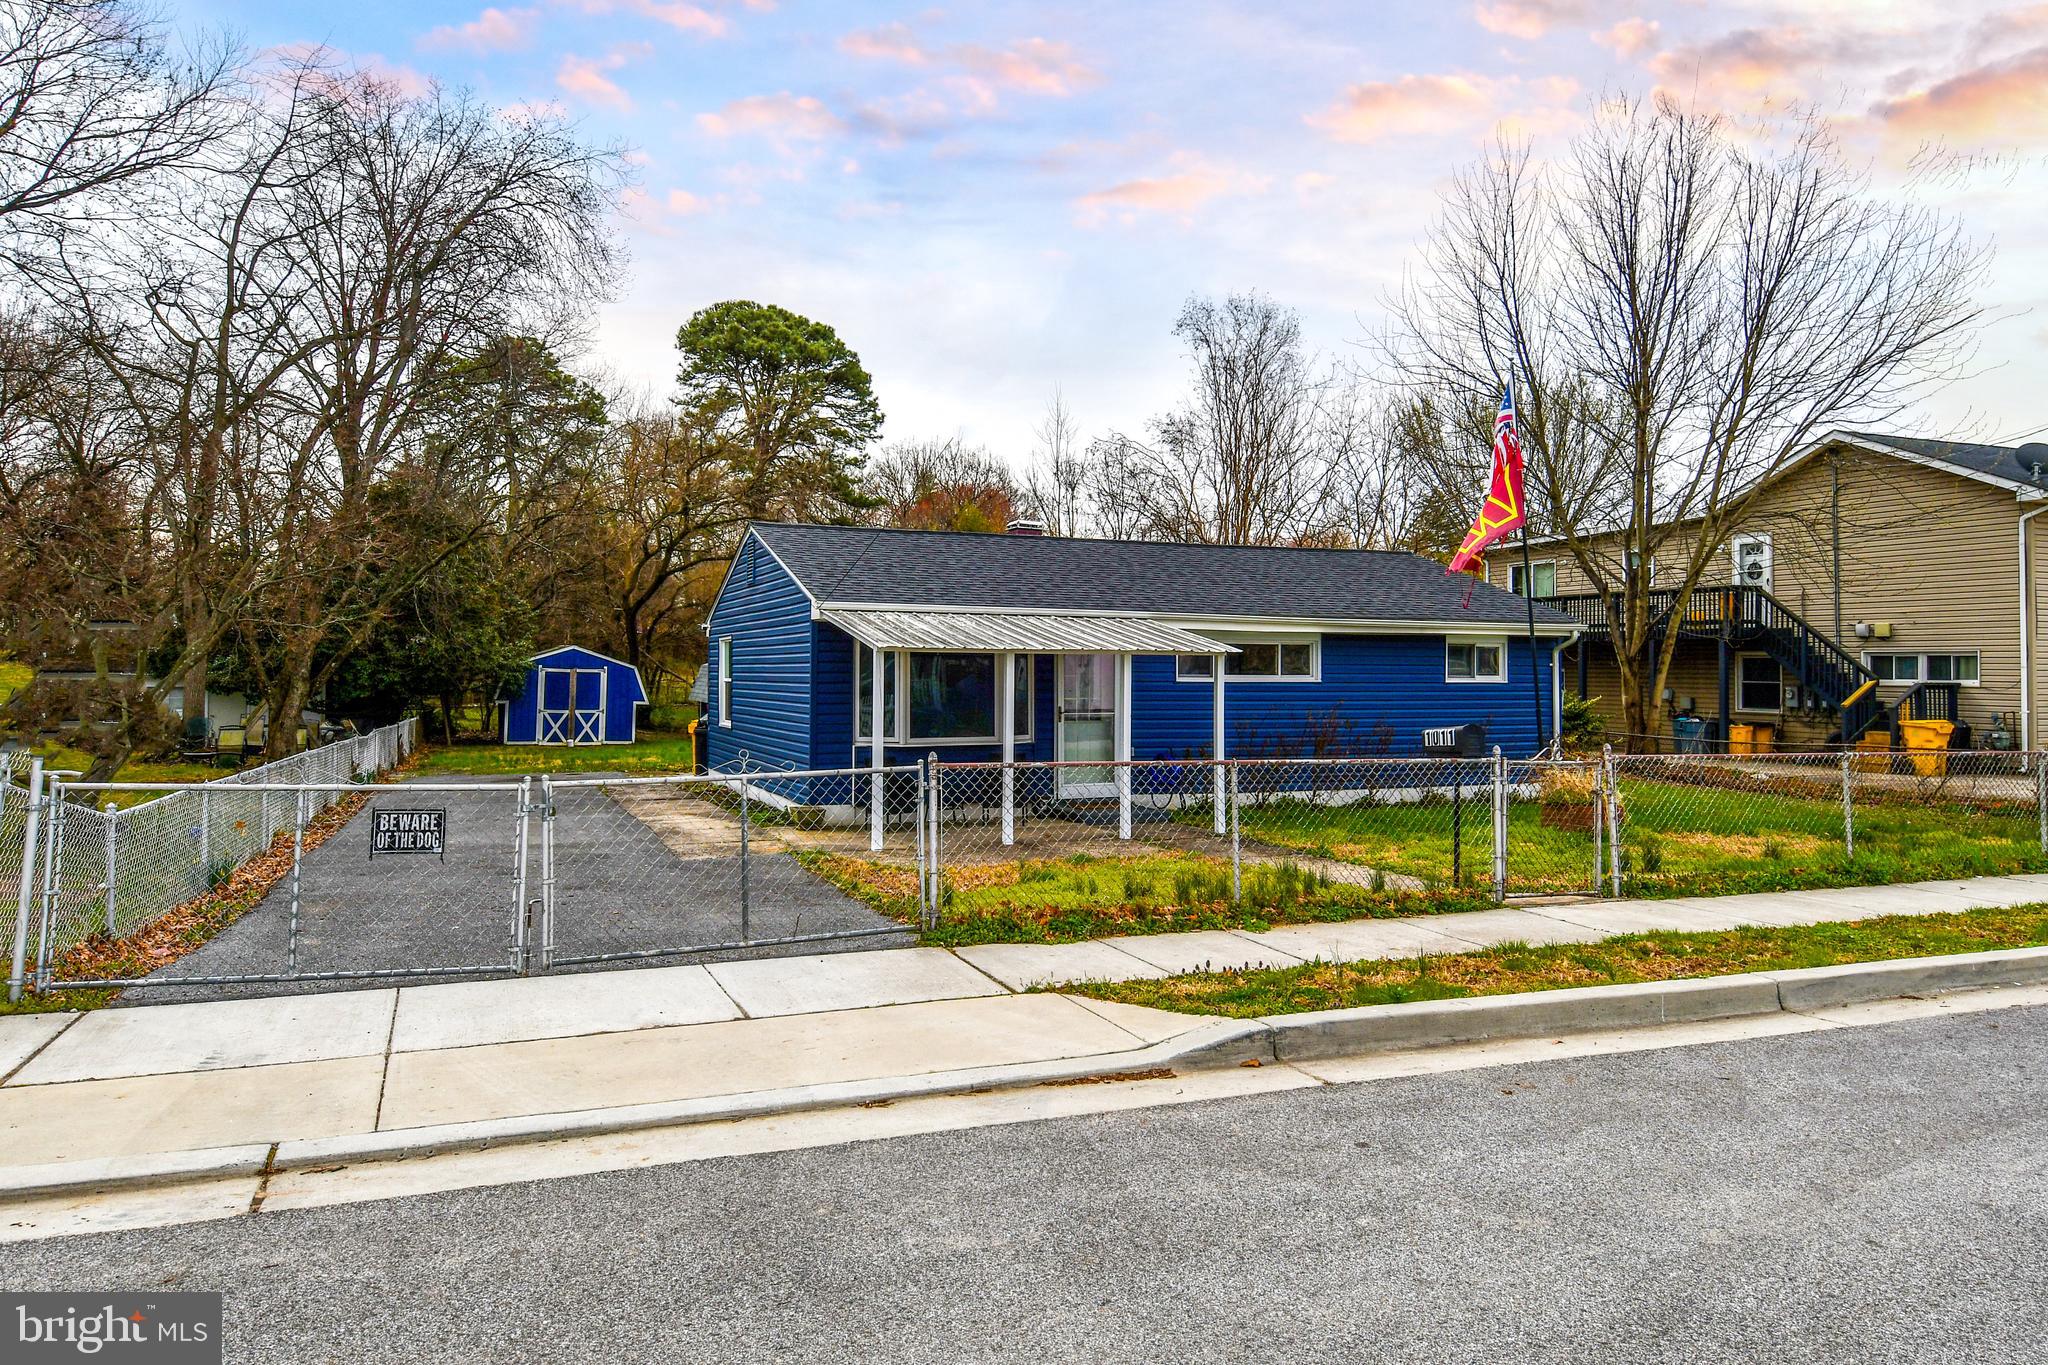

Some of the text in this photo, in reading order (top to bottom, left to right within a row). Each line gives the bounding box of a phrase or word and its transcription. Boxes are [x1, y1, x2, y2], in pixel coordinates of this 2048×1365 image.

[1426, 729, 1454, 746] 1011
[379, 814, 438, 830] BEWARE
[377, 832, 439, 848] OF THE DOG
